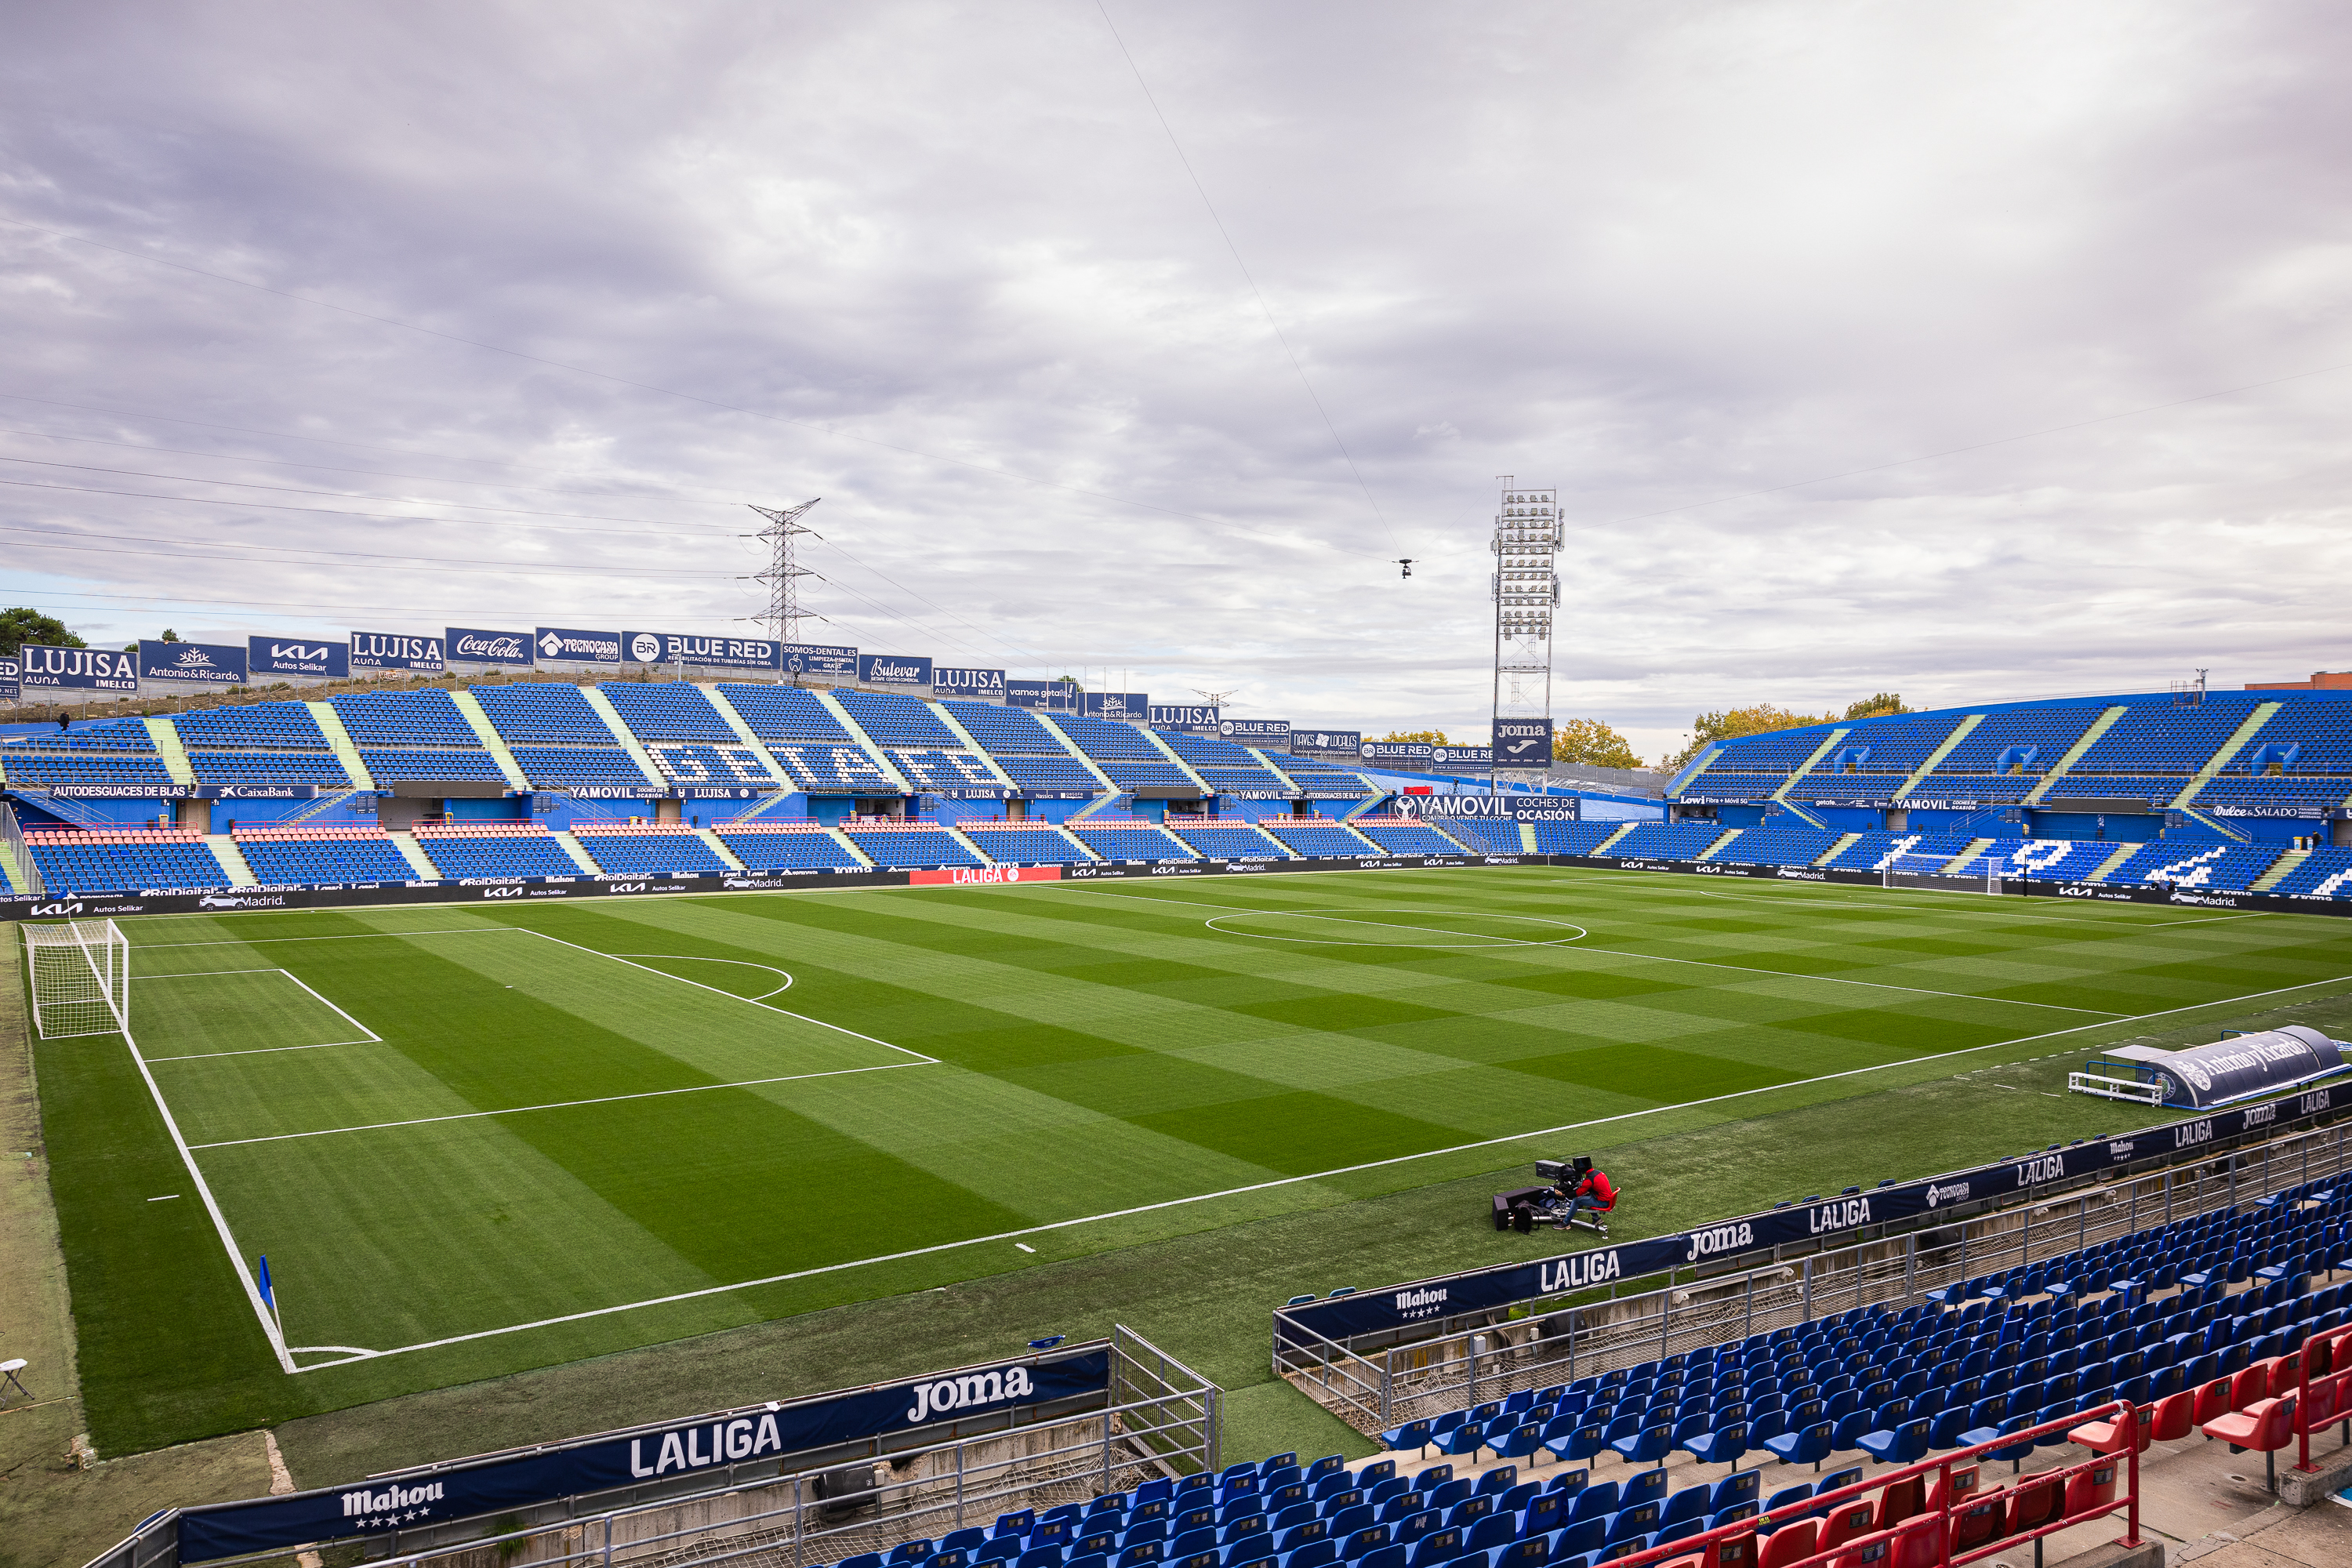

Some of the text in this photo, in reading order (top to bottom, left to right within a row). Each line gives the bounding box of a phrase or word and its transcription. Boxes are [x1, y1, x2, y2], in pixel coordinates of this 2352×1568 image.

[271, 644, 328, 661] KIA
[353, 634, 441, 661] LUJISA
[457, 634, 523, 658] Coca-Cola
[564, 638, 619, 655] TECNOCASA
[636, 641, 656, 654] BR
[667, 637, 771, 659] BLUE RED
[784, 645, 856, 657] SOMOS-DENTAL.ES
[24, 648, 135, 679] LUJISA
[272, 661, 327, 672] Autos Selikar
[354, 657, 382, 666] AUNA
[410, 661, 441, 670] IMELCO
[871, 658, 920, 677] Bulevar
[0, 662, 19, 676] ED
[25, 676, 60, 685] AUNA
[96, 679, 135, 689] IMELCO
[935, 670, 1004, 688] LUJISA
[1150, 707, 1218, 724] LUJISA
[1235, 722, 1289, 732] BLUE RED
[1497, 724, 1547, 738] Joma
[1294, 733, 1357, 747] NAVES LOCALES
[1376, 745, 1432, 754] BLUE RED
[1448, 750, 1493, 759] BLUE RE
[53, 786, 186, 797] AUTODESGUACES DE BLAS
[237, 786, 295, 798] CaixaBank
[570, 786, 634, 798] YAMOVIL
[695, 788, 731, 798] LUJISA
[965, 789, 996, 799] LUJISA
[1240, 790, 1281, 800] YAMOVIL
[1417, 796, 1575, 815] YAMOVIL COCHES DE
[1679, 795, 1705, 805] Lowi
[1895, 800, 1950, 810] YAMOVIL
[1516, 808, 1575, 821] OCASIÓN
[2213, 805, 2248, 817] Dulce
[2254, 807, 2297, 817] SALADO
[953, 869, 1003, 884] LALIGA
[1801, 871, 1826, 880] Madrid.
[753, 878, 784, 888] Madrid.
[241, 895, 286, 907] Madrid.
[2201, 895, 2238, 907] Madrid.
[2301, 1090, 2330, 1114] LALIGA
[2243, 1103, 2276, 1130] Joma
[2176, 1120, 2212, 1148] LALIGA
[2110, 1140, 2134, 1155] Mahou
[2017, 1155, 2063, 1186] LALIGA
[1939, 1181, 1969, 1200] TECNOCASA
[1810, 1198, 1871, 1234] LALIGA
[1687, 1221, 1754, 1261] Joma
[1541, 1250, 1621, 1294] LALIGA
[1396, 1287, 1448, 1310] Mahou
[907, 1366, 1033, 1423] Joma
[631, 1414, 782, 1478] LALIGA
[342, 1480, 445, 1518] Mahou
